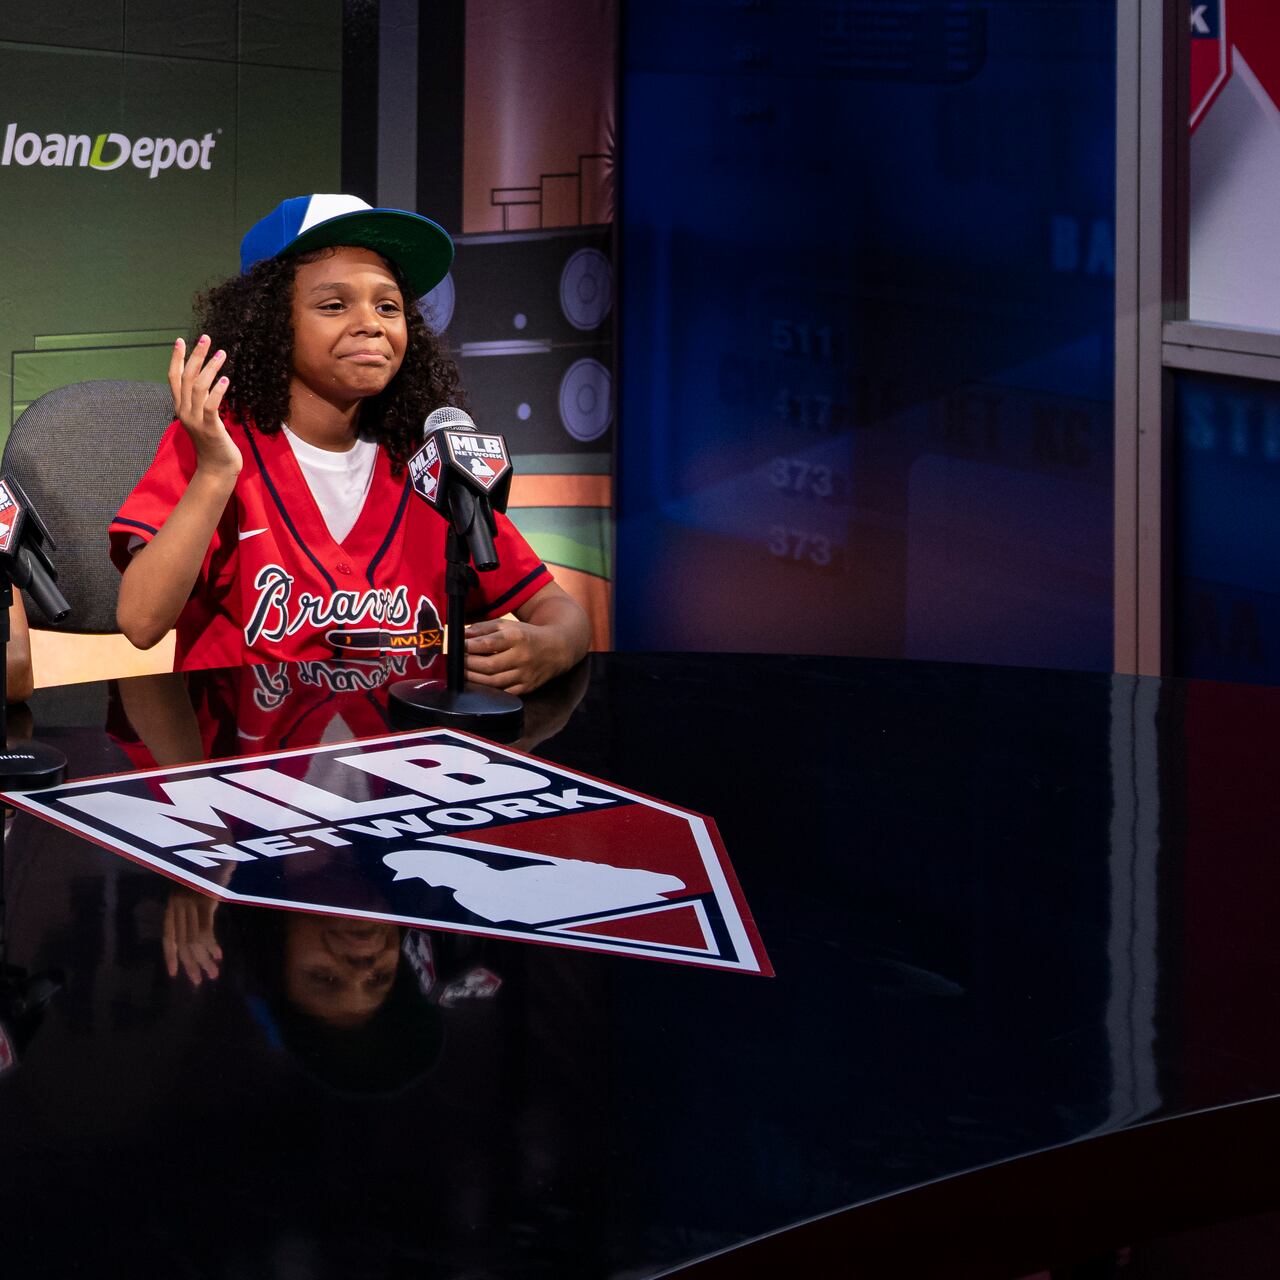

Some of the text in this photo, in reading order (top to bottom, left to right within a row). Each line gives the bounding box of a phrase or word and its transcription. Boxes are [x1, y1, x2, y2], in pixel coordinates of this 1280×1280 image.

[1, 123, 216, 179] loanDepot
[772, 319, 831, 357] 511
[410, 442, 437, 476] MLB
[450, 435, 502, 454] MLB
[454, 450, 503, 460] NETWORK
[769, 456, 832, 497] 373
[769, 524, 831, 566] 373
[245, 564, 411, 647] Braves
[56, 744, 552, 848] MLB
[172, 787, 620, 868] NETWORK
